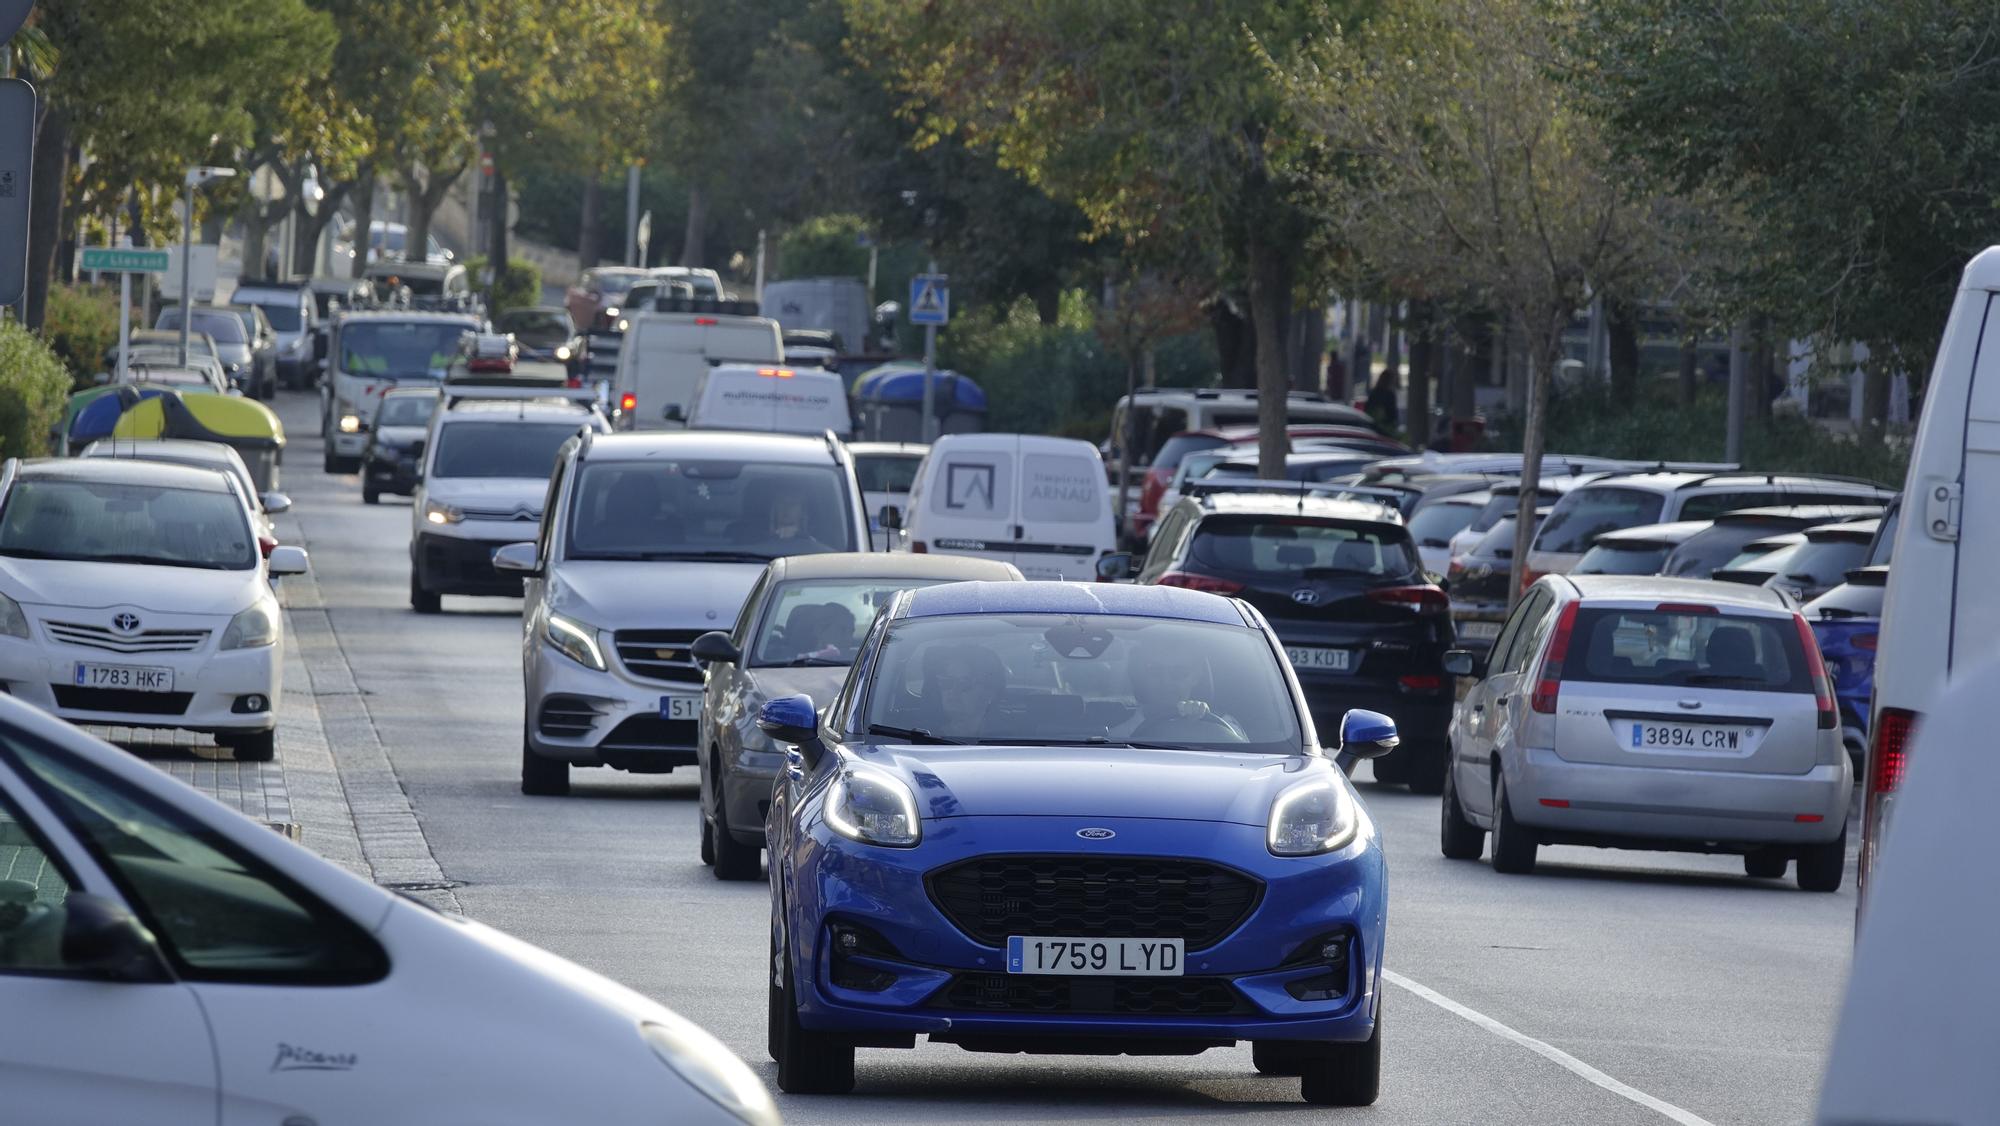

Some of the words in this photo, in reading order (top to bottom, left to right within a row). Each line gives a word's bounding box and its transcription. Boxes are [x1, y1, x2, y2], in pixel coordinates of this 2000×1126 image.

[1030, 485, 1092, 503] ARNAU
[1314, 650, 1345, 666] KDT
[92, 668, 130, 685] 1783
[135, 671, 167, 687] HKF
[672, 699, 702, 717] 51
[1646, 727, 1695, 746] 3894
[1702, 729, 1738, 749] CRW
[1034, 942, 1107, 970] 1759
[1119, 943, 1177, 971] LYD
